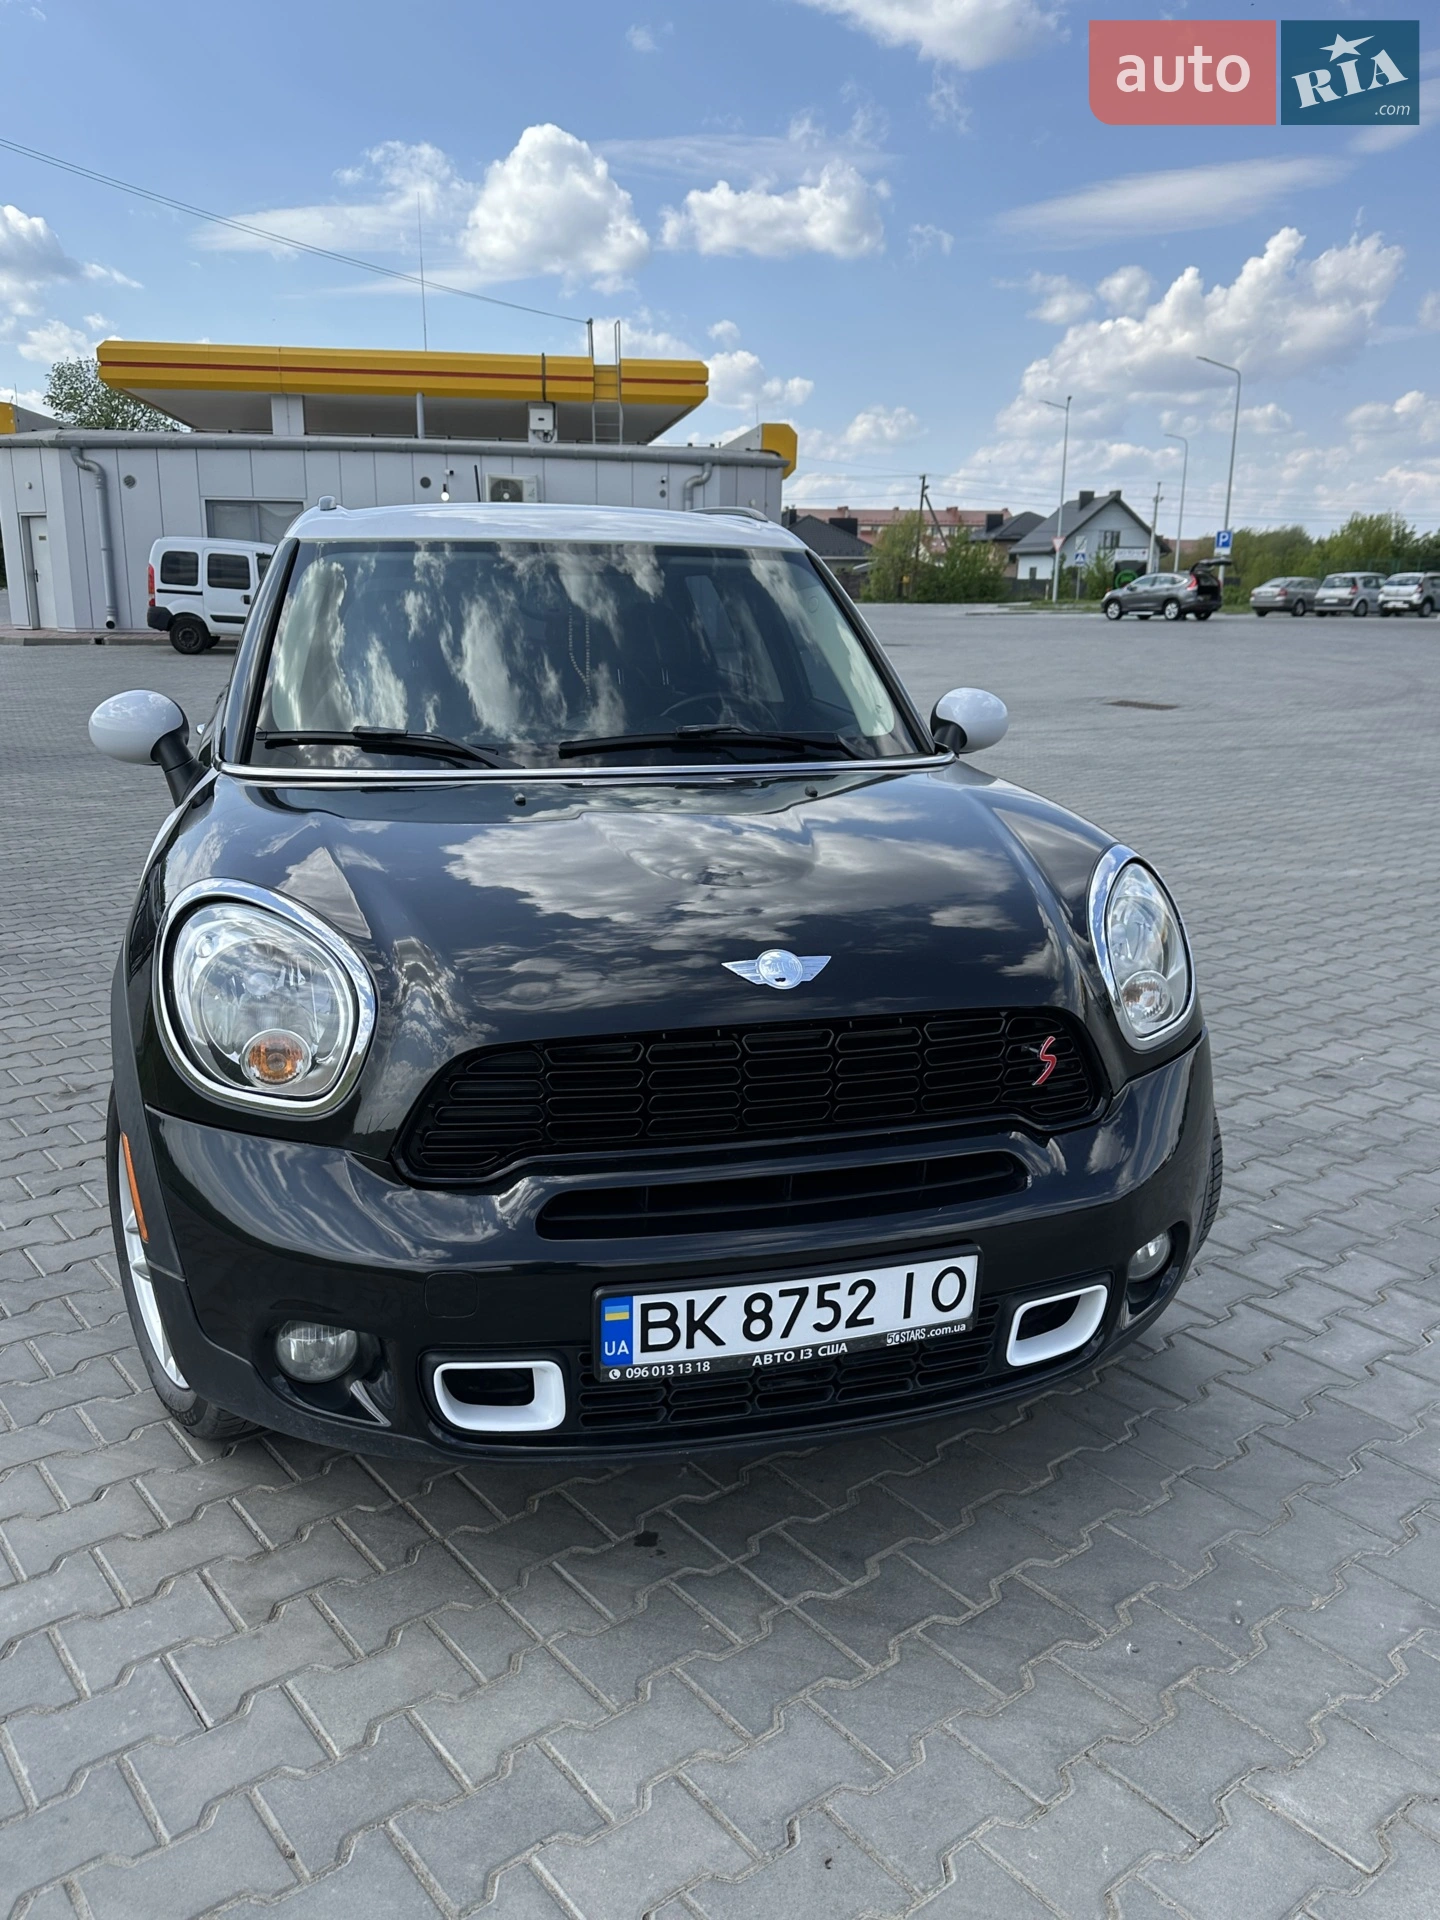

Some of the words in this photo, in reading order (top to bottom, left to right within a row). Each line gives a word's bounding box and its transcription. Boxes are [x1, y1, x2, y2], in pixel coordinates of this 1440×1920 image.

[1219, 532, 1229, 546] P
[1032, 1036, 1057, 1086] S
[640, 1295, 728, 1353] BK
[742, 1278, 877, 1342] 8752
[604, 1339, 630, 1356] UA
[752, 1351, 795, 1366] АВТО
[818, 1343, 848, 1357] США
[625, 1367, 649, 1379] 096
[651, 1364, 674, 1377] 013
[678, 1363, 692, 1374] 13
[696, 1361, 711, 1373] 18
